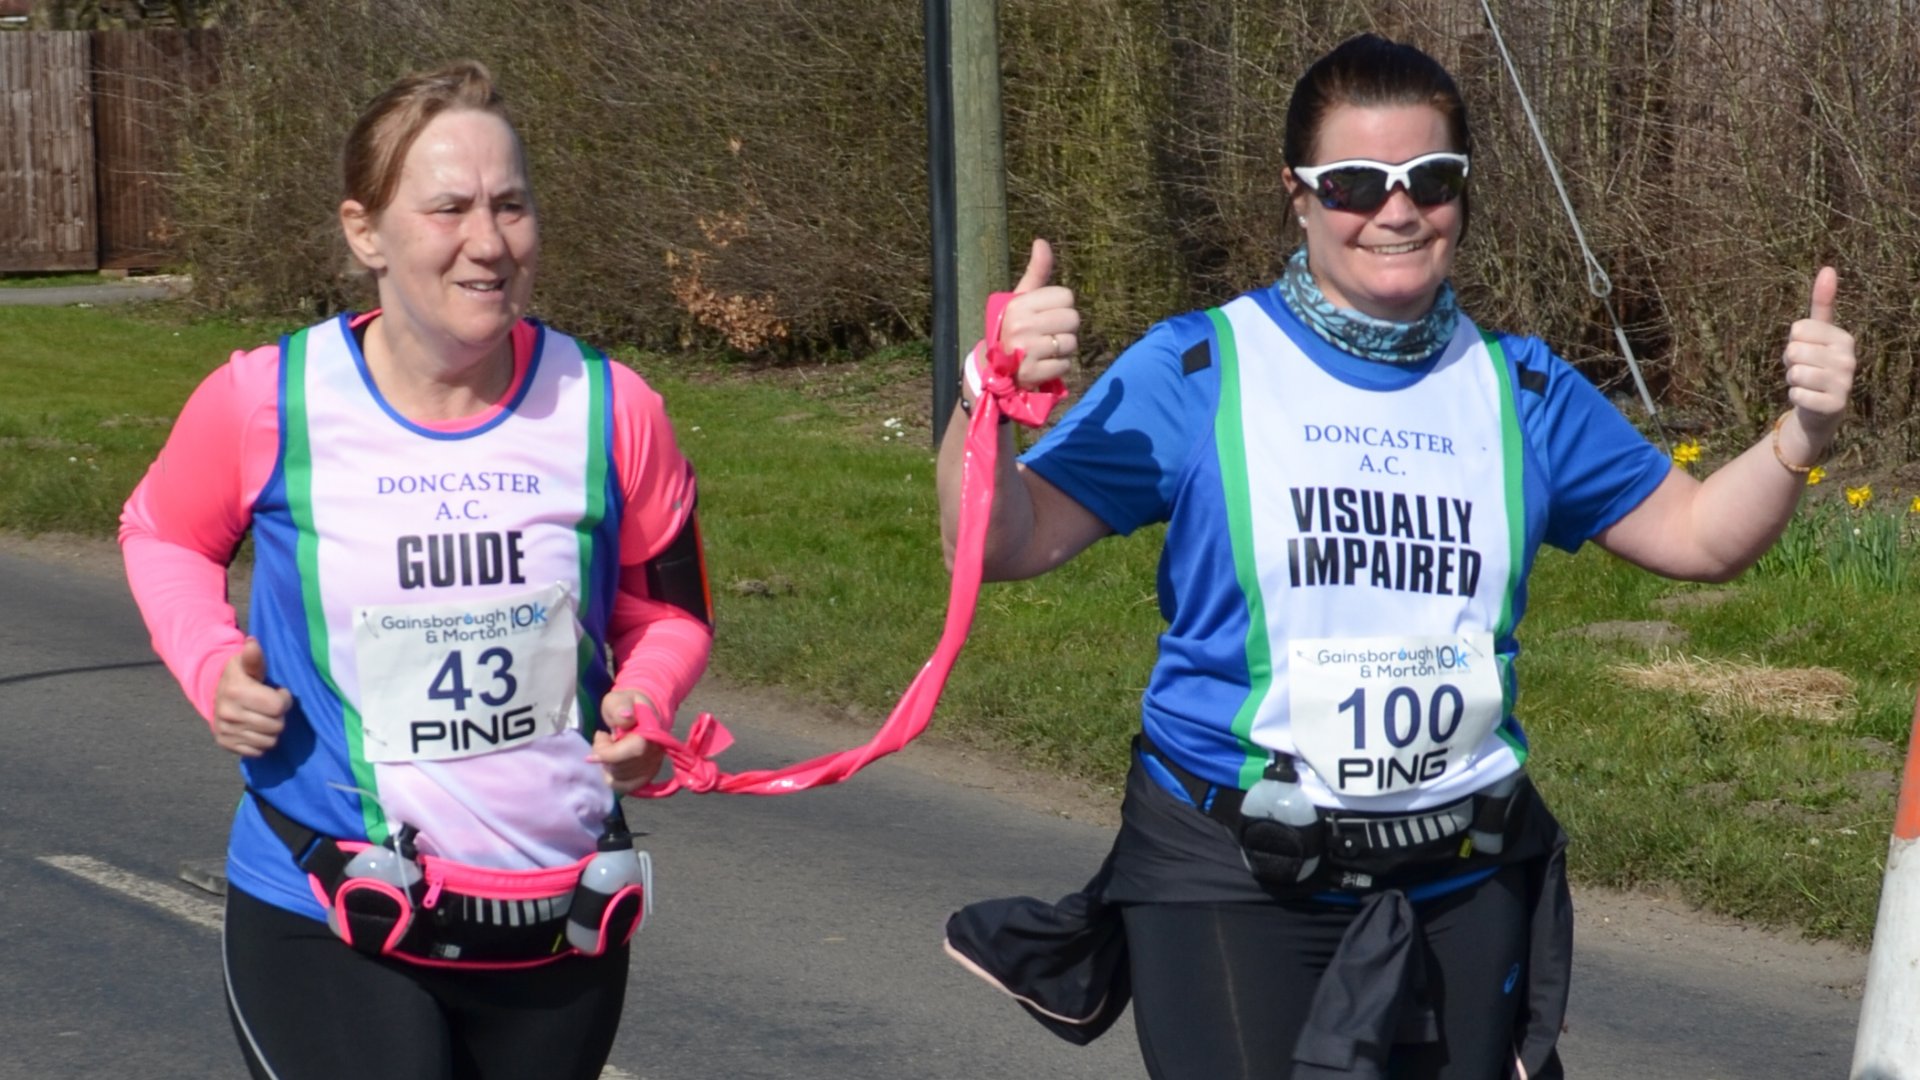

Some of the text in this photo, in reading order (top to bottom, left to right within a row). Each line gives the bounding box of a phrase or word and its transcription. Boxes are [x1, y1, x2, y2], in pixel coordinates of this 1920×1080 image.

[1304, 424, 1455, 455] DONCASTER
[1359, 454, 1406, 476] A.C.
[377, 472, 541, 495] DONCASTER
[435, 500, 488, 520] A.C.
[1289, 487, 1472, 544] VISUALLY
[397, 530, 526, 589] GUIDE
[1287, 537, 1482, 598] IMPAIRED
[381, 609, 507, 631] Gainsborough
[425, 629, 440, 644] &
[443, 626, 507, 642] Morton
[1317, 646, 1434, 666] Gainsborough
[1360, 664, 1372, 678] &
[1377, 665, 1436, 678] Morton
[428, 646, 518, 712] 43
[411, 704, 537, 754] PING
[1338, 683, 1465, 750] 100
[1338, 747, 1449, 790] PING
